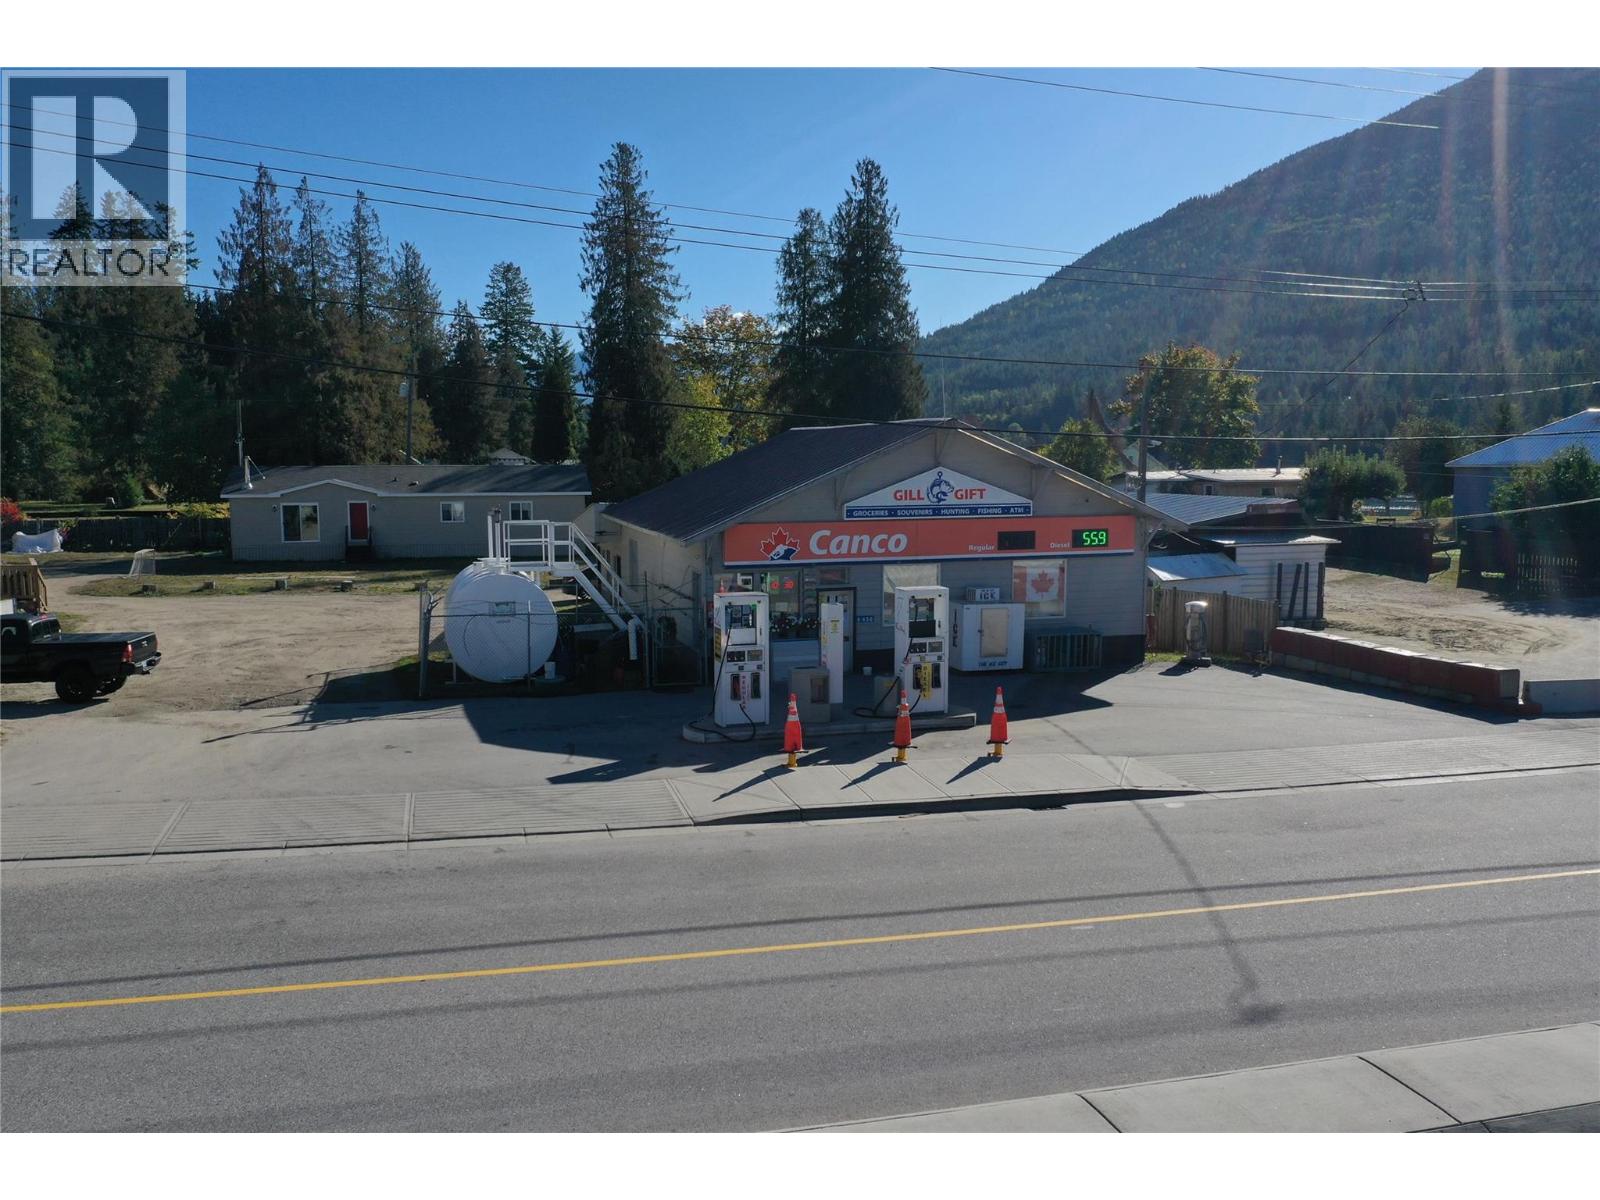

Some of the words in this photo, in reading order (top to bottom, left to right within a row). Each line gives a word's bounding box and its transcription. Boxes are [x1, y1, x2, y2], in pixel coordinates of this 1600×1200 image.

[893, 489, 925, 501] GILL
[954, 488, 986, 500] GIFT
[853, 509, 888, 517] GROCERIES
[897, 508, 933, 516] SOUVENIRS
[809, 529, 908, 555] Canco
[968, 544, 995, 553] Regular
